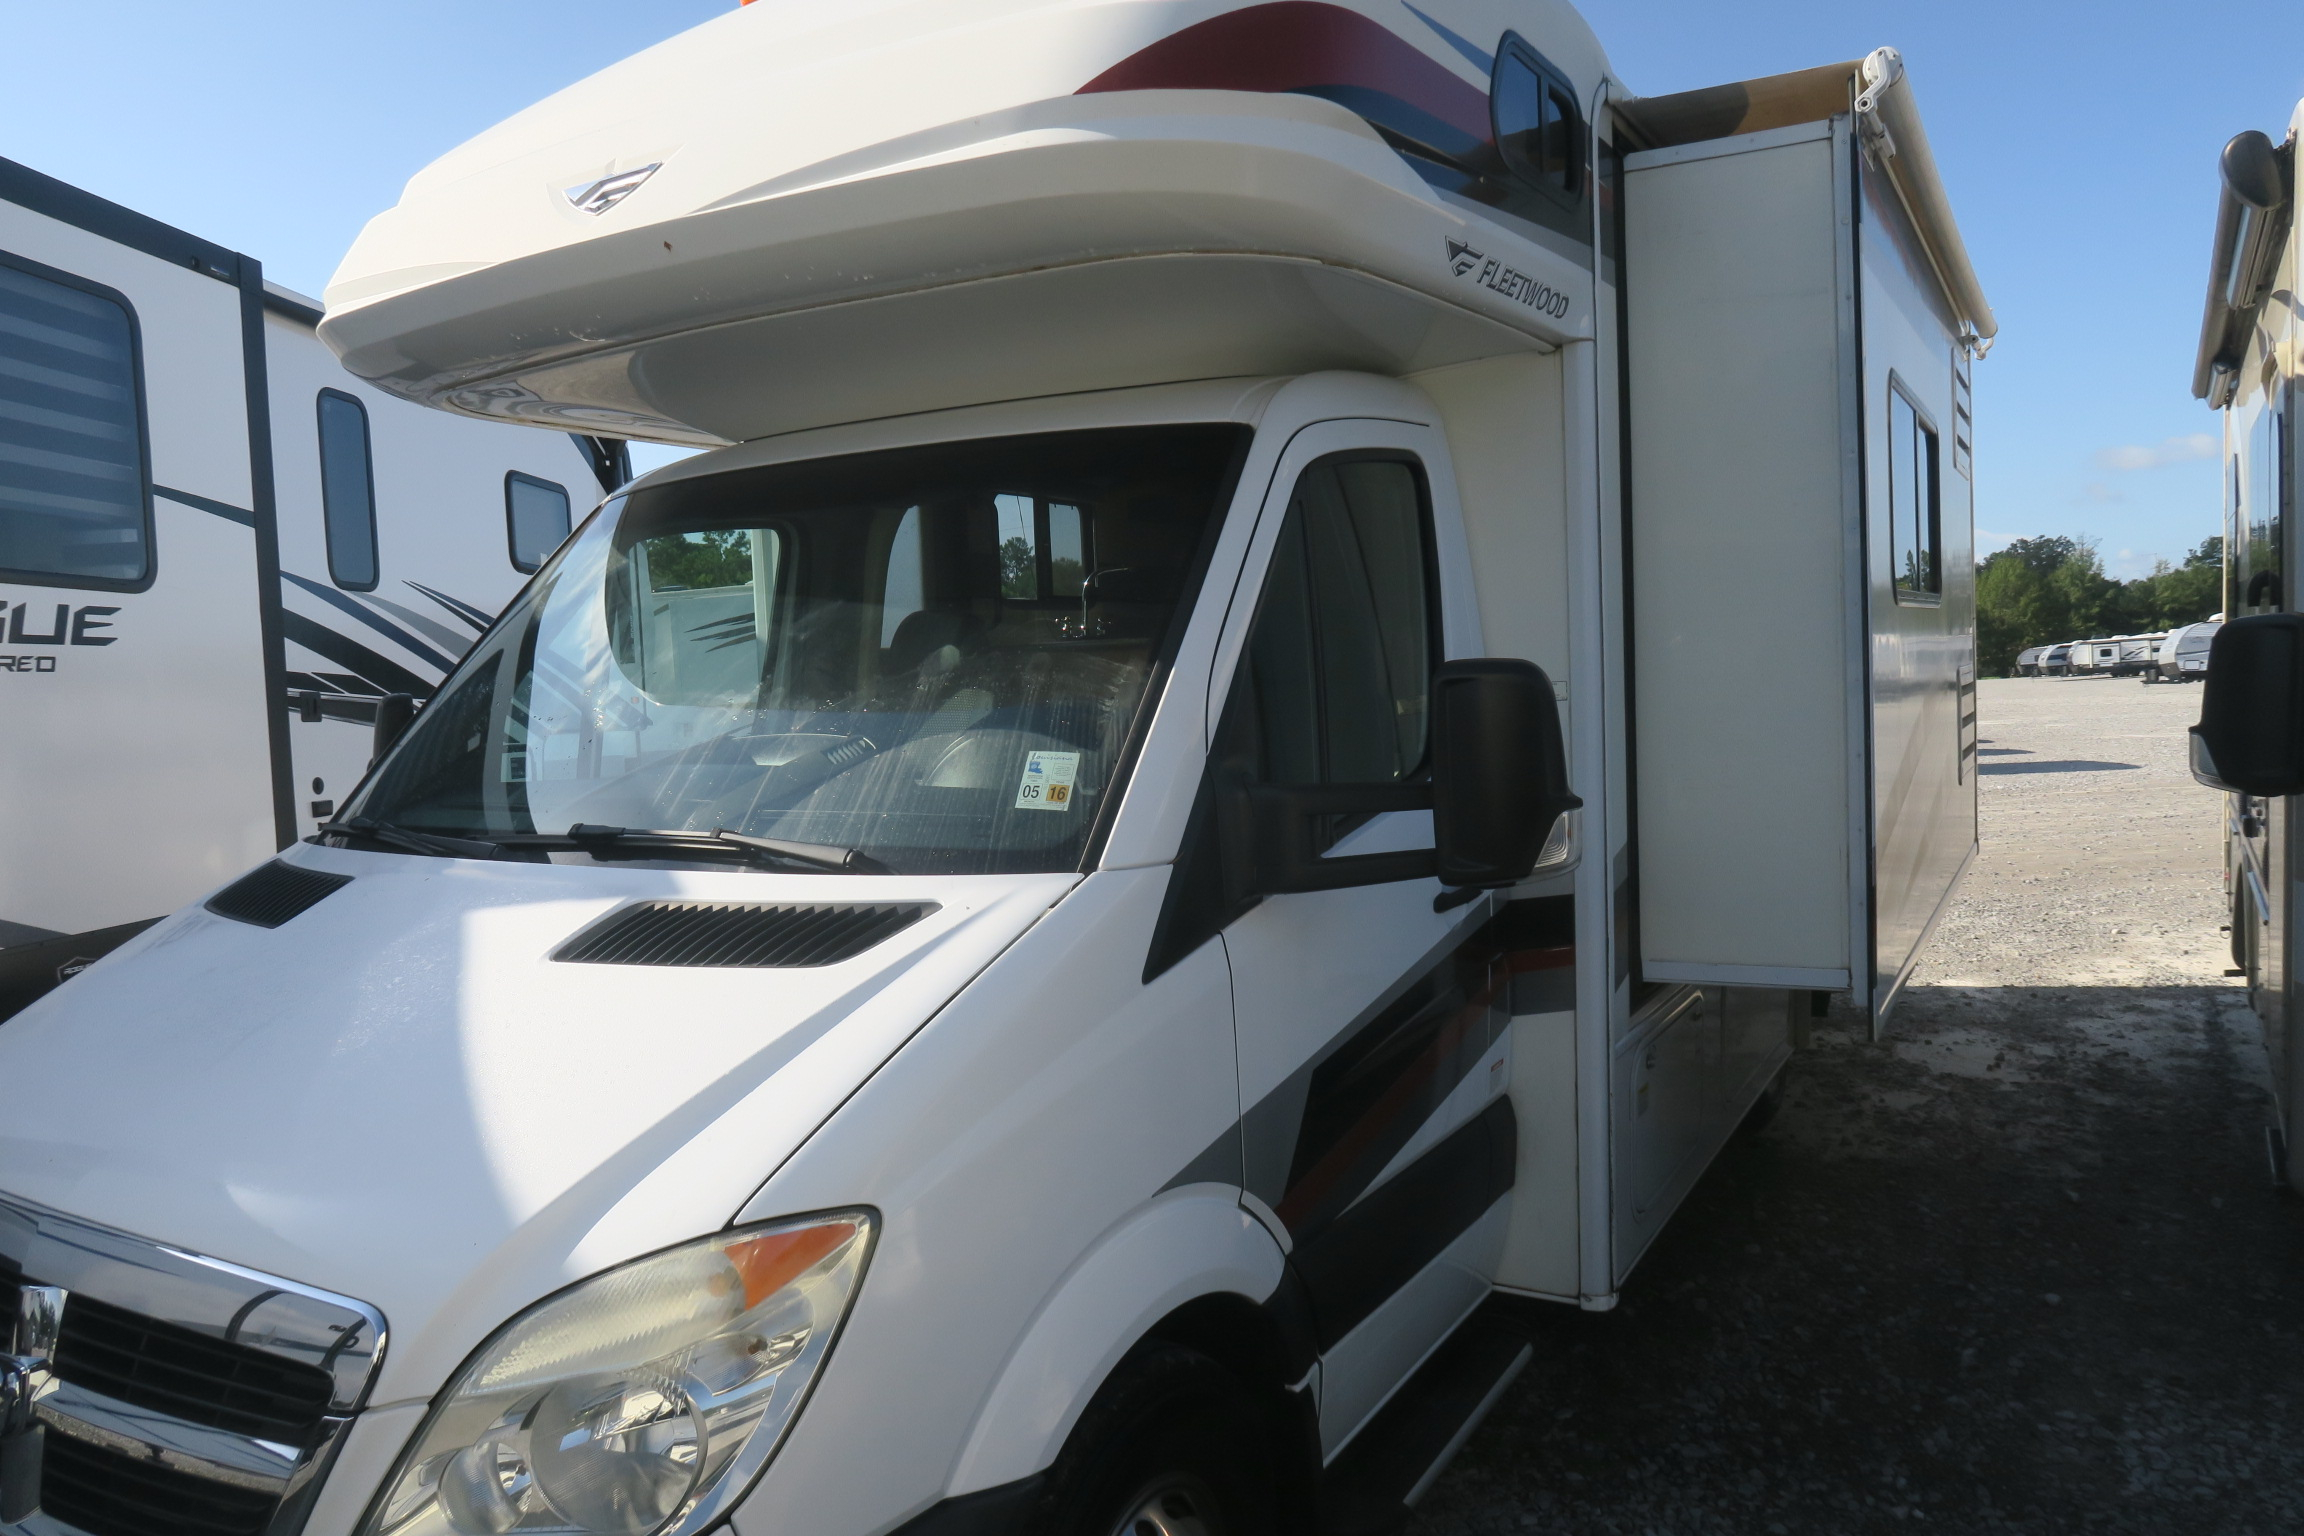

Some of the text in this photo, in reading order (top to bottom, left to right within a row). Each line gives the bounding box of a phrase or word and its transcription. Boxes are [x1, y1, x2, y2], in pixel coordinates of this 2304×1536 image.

[1476, 256, 1570, 319] FLEETWOOD
[0, 600, 122, 646] UE
[1022, 784, 1040, 799] 05
[1050, 786, 1067, 801] 16
